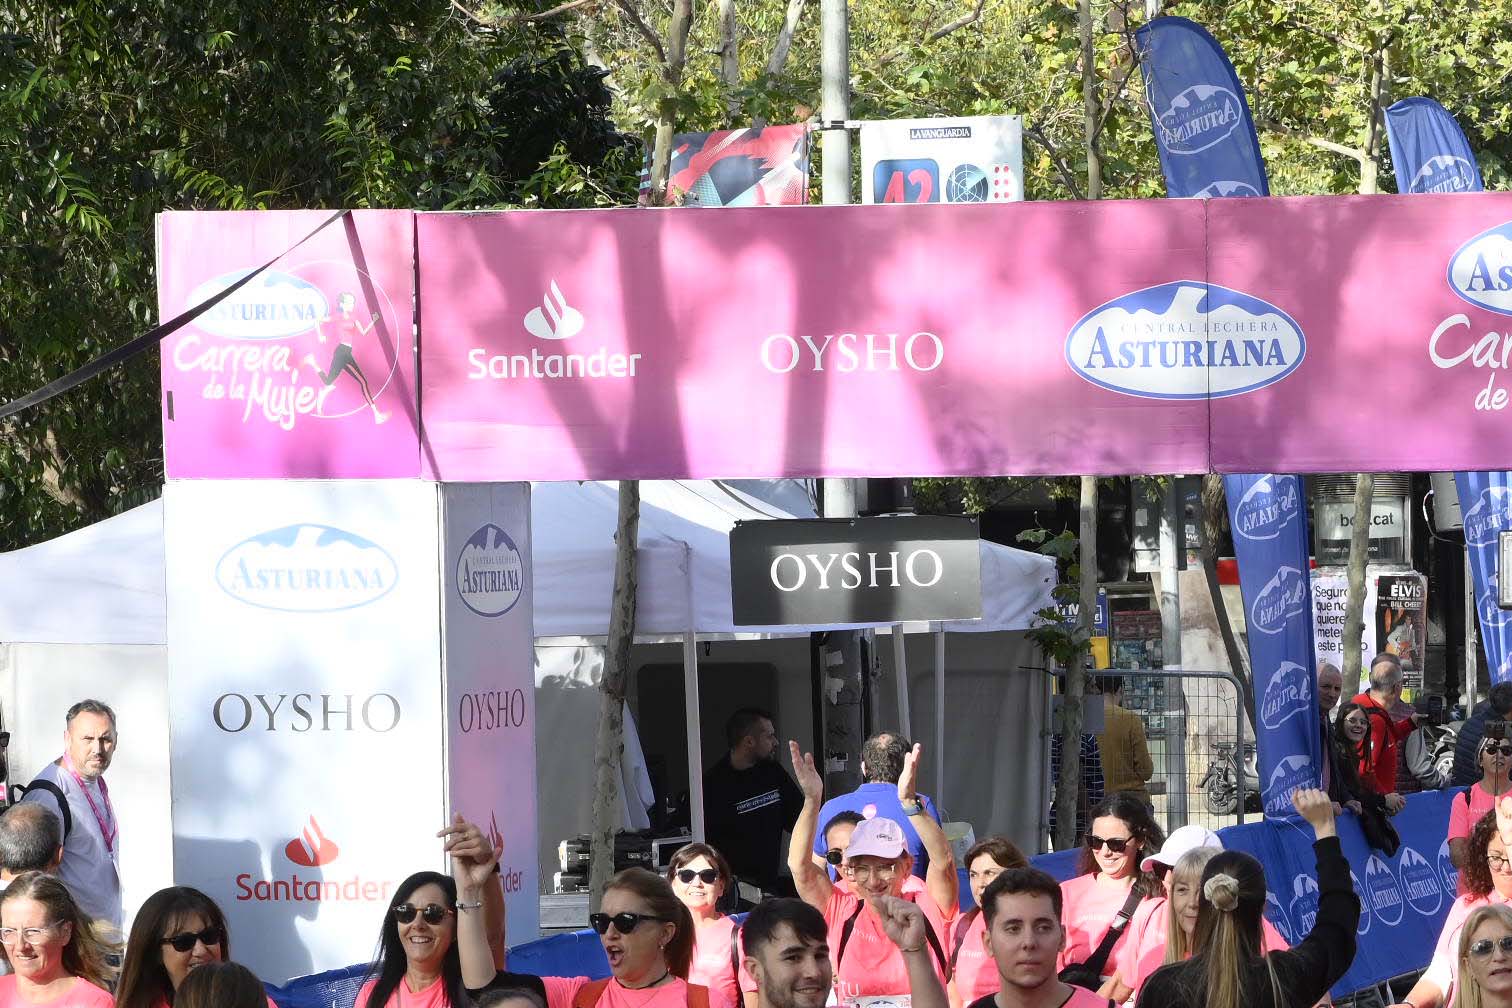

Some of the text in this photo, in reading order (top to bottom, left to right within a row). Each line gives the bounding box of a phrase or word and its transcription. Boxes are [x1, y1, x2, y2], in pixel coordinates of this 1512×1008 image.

[921, 127, 970, 138] VANGUARDIA
[206, 303, 318, 321] STURIANA
[1203, 320, 1279, 332] LECHERA
[173, 336, 290, 373] Carrera
[467, 347, 642, 379] Santander
[760, 332, 945, 374] OYSHO
[1083, 326, 1288, 369] ASTURIANA
[203, 367, 336, 431] de la Mujer
[1474, 372, 1507, 411] de
[1340, 511, 1395, 527] bc.cat
[230, 557, 385, 590] ASTURIANA
[462, 562, 520, 594] ASTURIANA
[769, 548, 944, 592] OYSHO
[1391, 584, 1421, 597] ELVIS
[1316, 602, 1332, 614] que
[1317, 614, 1348, 626] quiere
[1318, 641, 1336, 651] este
[213, 693, 401, 733] OYSHO
[459, 688, 526, 733] OYSHO
[236, 873, 391, 902] Santander
